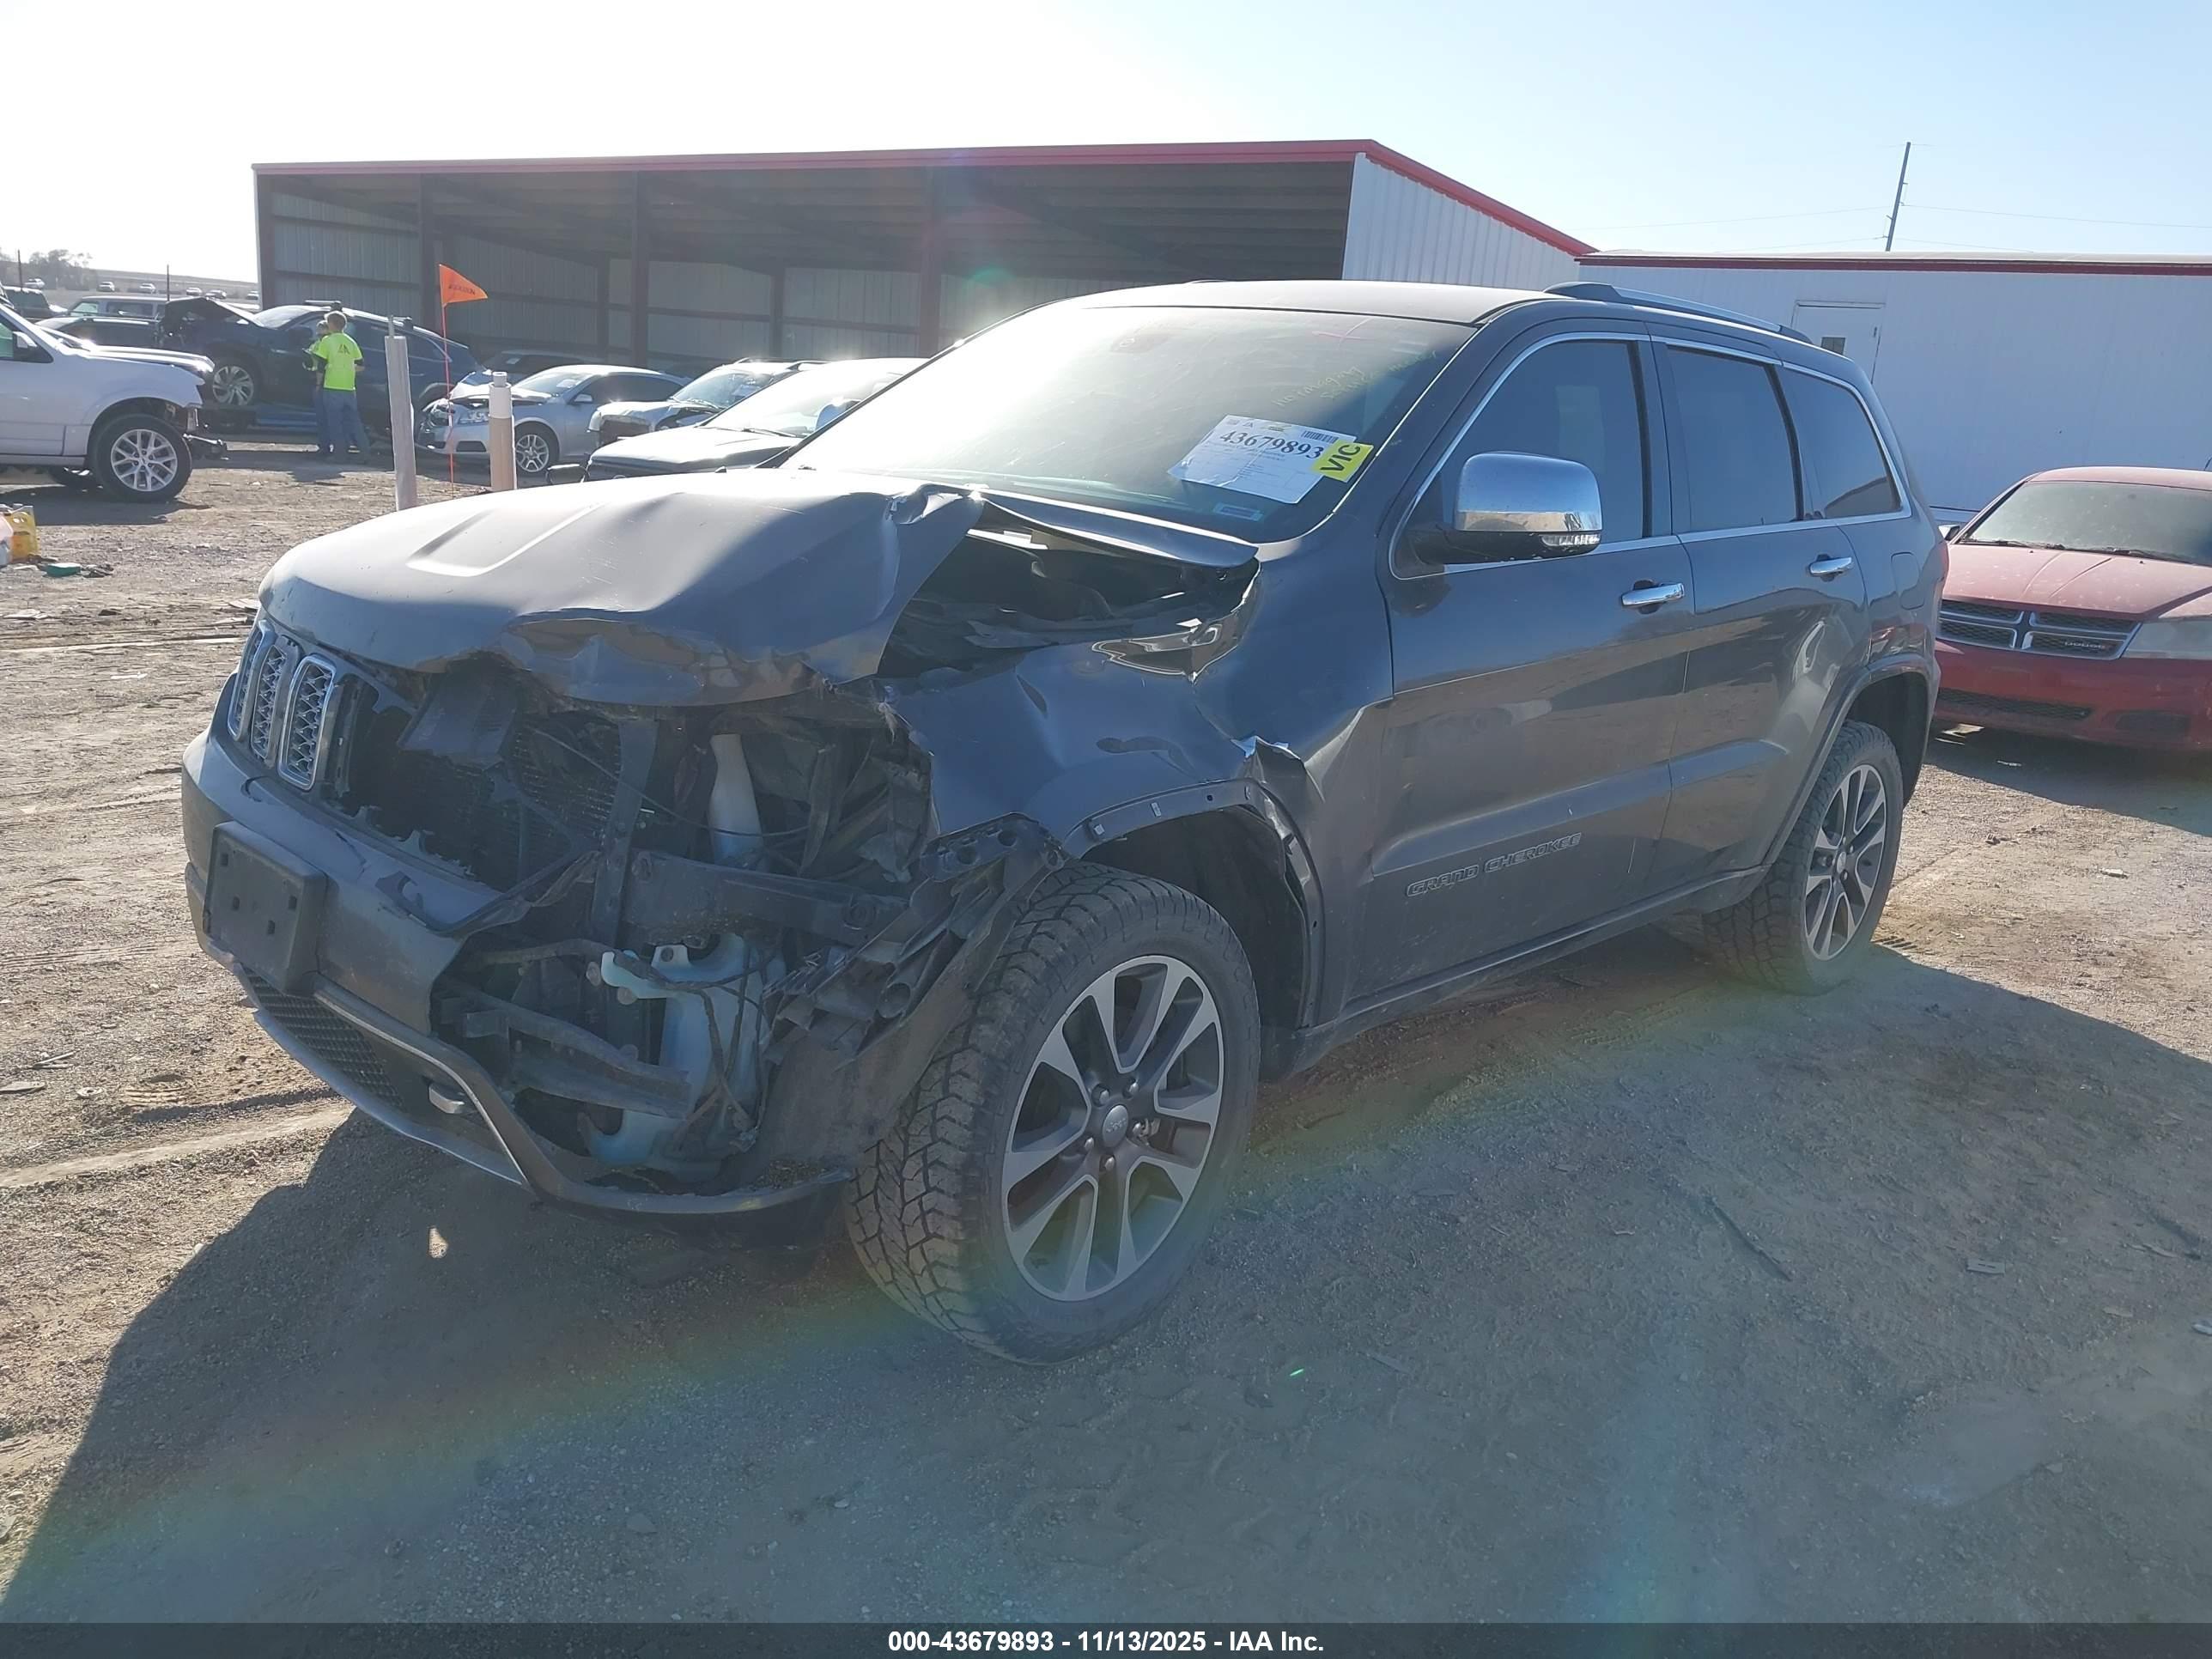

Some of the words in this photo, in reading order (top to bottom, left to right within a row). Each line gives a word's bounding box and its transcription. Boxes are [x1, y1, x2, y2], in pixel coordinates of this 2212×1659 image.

[1219, 430, 1324, 459] 43679893
[1319, 444, 1361, 471] VIC
[1406, 864, 1480, 897] GRAND
[1484, 831, 1582, 873] CHEROKEE
